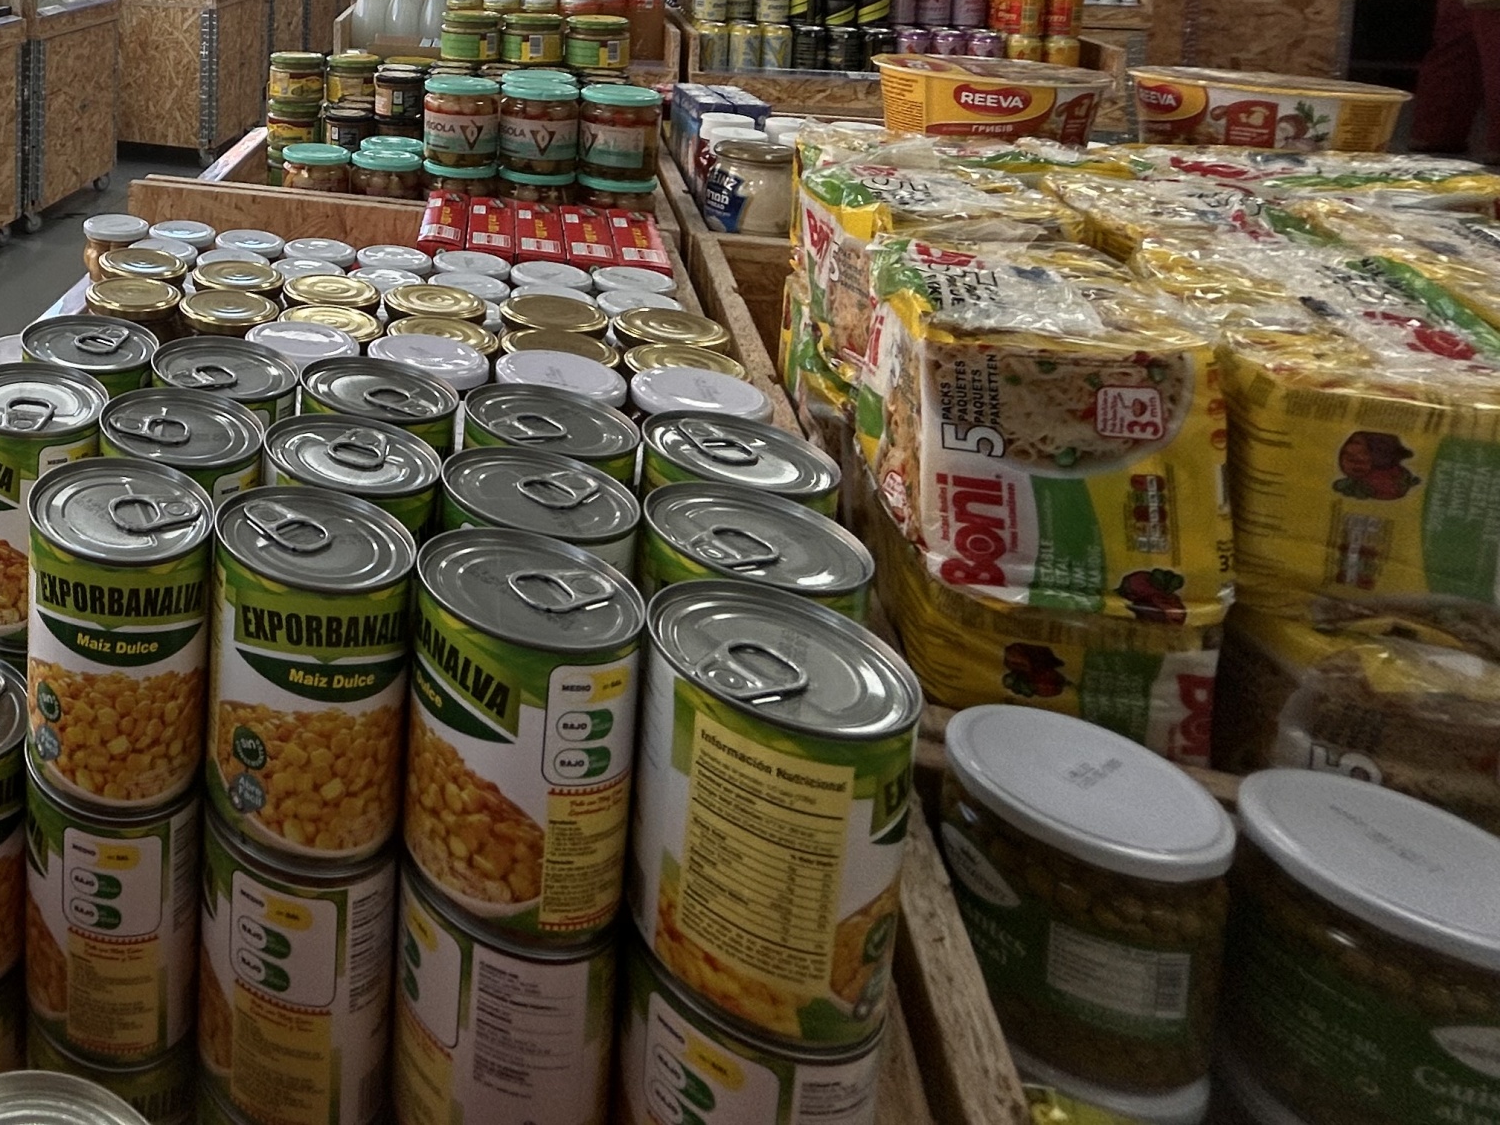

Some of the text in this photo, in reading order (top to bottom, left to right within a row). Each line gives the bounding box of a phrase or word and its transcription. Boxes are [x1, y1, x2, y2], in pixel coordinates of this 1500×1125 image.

[960, 90, 1024, 109] REEVA
[941, 381, 951, 420] PACKS
[954, 359, 968, 423] PAQUETES
[970, 368, 983, 424] PAQUETS
[986, 353, 999, 426] PAKKETTEN
[1127, 396, 1160, 436] 3 min
[941, 422, 1006, 458] 5
[939, 472, 1007, 588] Boni
[1039, 539, 1054, 583] ETABLE
[240, 605, 406, 649] EXPORBANAL
[115, 639, 159, 655] Dulce
[332, 673, 375, 690] Dulce
[561, 683, 591, 693] MEDIO
[562, 722, 587, 731] BAJO
[559, 759, 585, 768] BAJO
[700, 728, 846, 793] Información Nutricional
